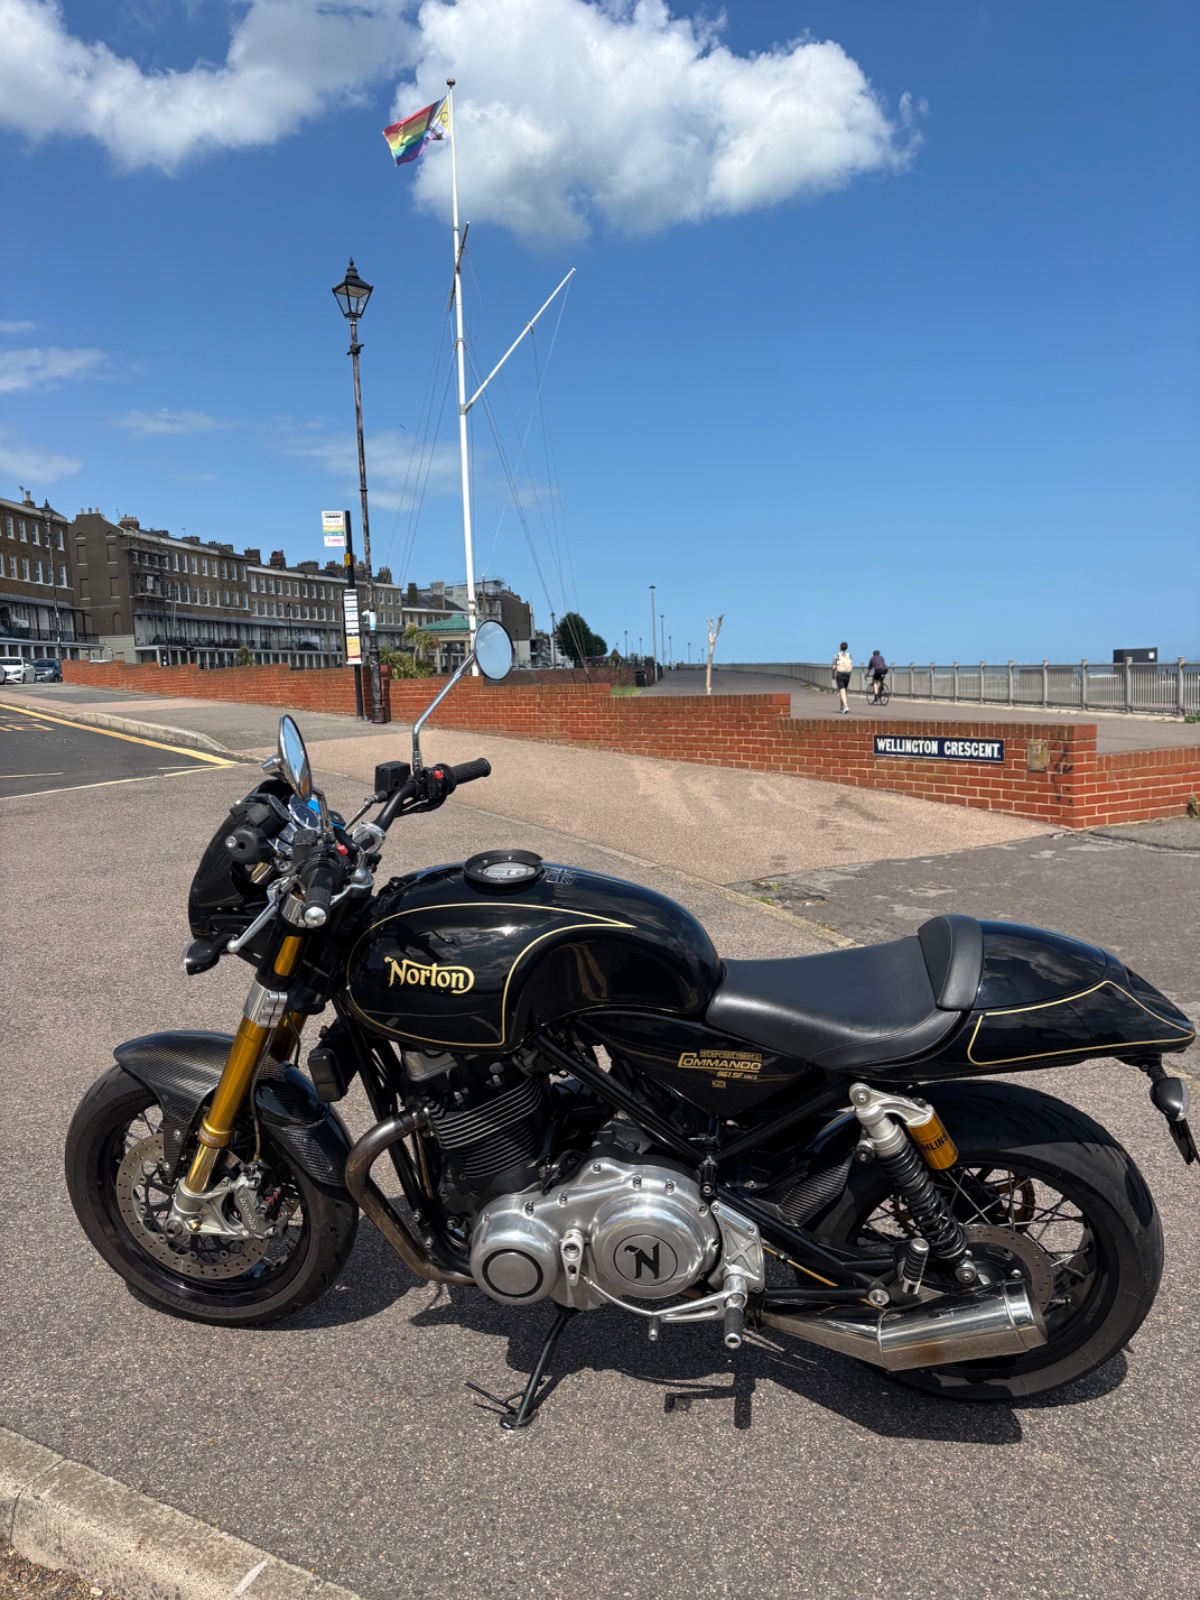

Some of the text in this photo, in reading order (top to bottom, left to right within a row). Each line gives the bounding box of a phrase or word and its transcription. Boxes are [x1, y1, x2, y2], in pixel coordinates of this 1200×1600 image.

[876, 738, 939, 755] WELLINGTON
[383, 956, 475, 994] Norton
[677, 1052, 762, 1073] COMMANDO
[623, 1241, 660, 1280] N
